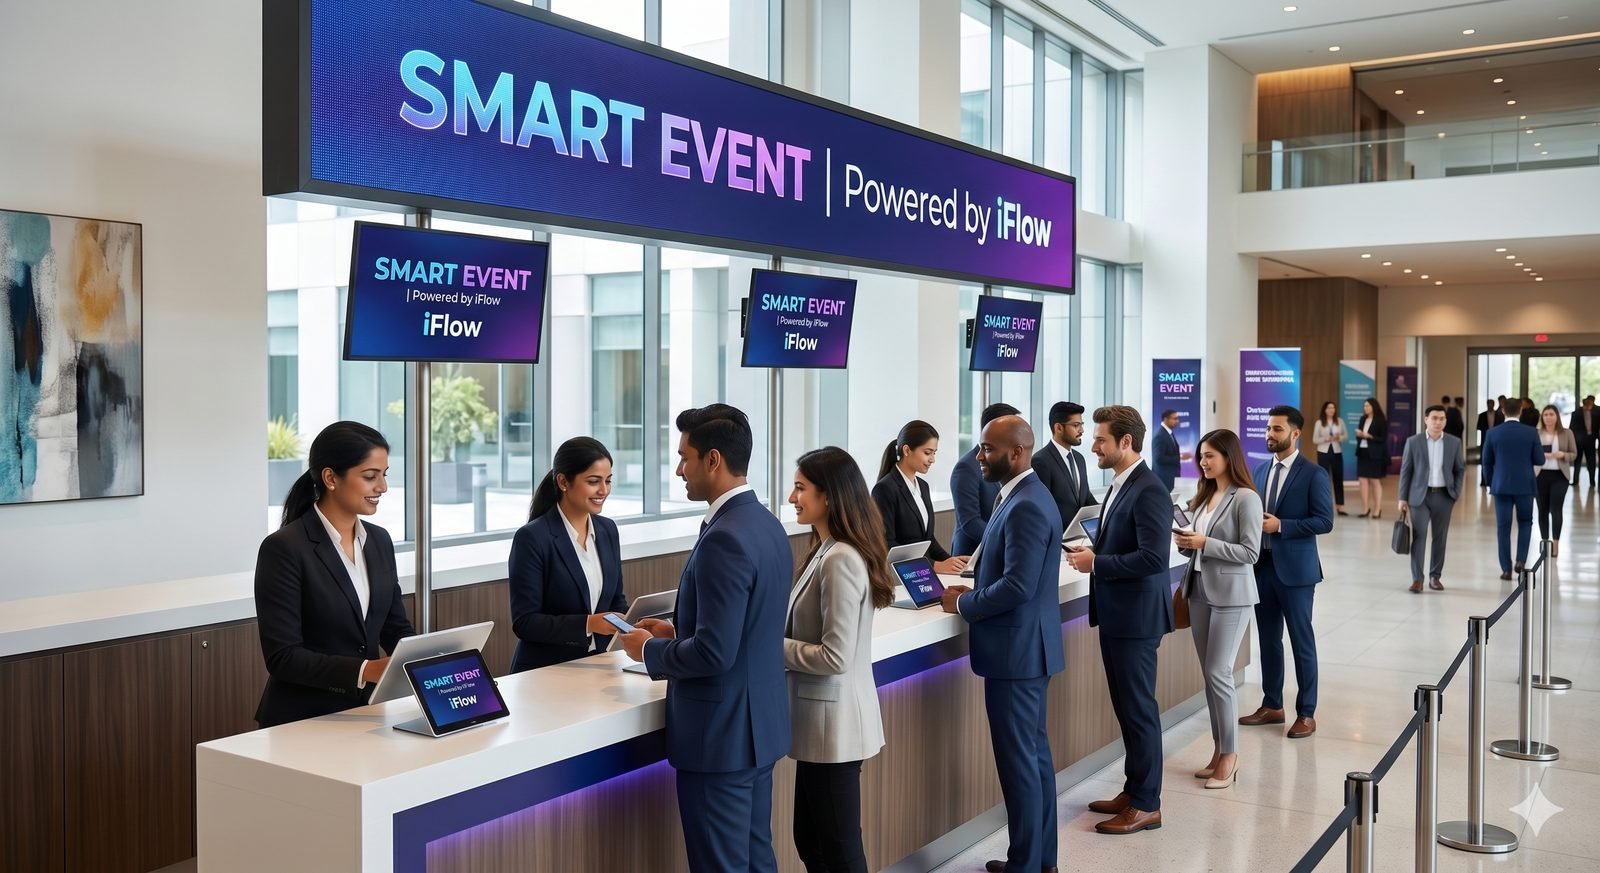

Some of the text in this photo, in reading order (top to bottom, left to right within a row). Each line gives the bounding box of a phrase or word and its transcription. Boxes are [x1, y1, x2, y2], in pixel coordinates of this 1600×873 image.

[400, 49, 645, 168] SMART
[661, 112, 811, 201] EVENT
[845, 163, 957, 230] Powered
[965, 190, 992, 246] by
[997, 196, 1052, 248] iFlow
[374, 256, 532, 291] SMART EVENT
[412, 289, 458, 304] Powered
[460, 292, 473, 307] by
[474, 293, 501, 306] iFlow
[761, 293, 846, 316] SMART EVENT
[423, 311, 483, 338] iFlow
[780, 315, 805, 326] Powered
[805, 317, 813, 329] by
[983, 314, 1036, 331] SMART EVENT
[784, 331, 818, 351] iFlow
[997, 343, 1019, 358] iFlow
[1158, 372, 1195, 382] SMART
[1159, 383, 1194, 393] EVENT
[424, 669, 480, 689] SMART EVENT
[448, 695, 477, 709] iFlow
